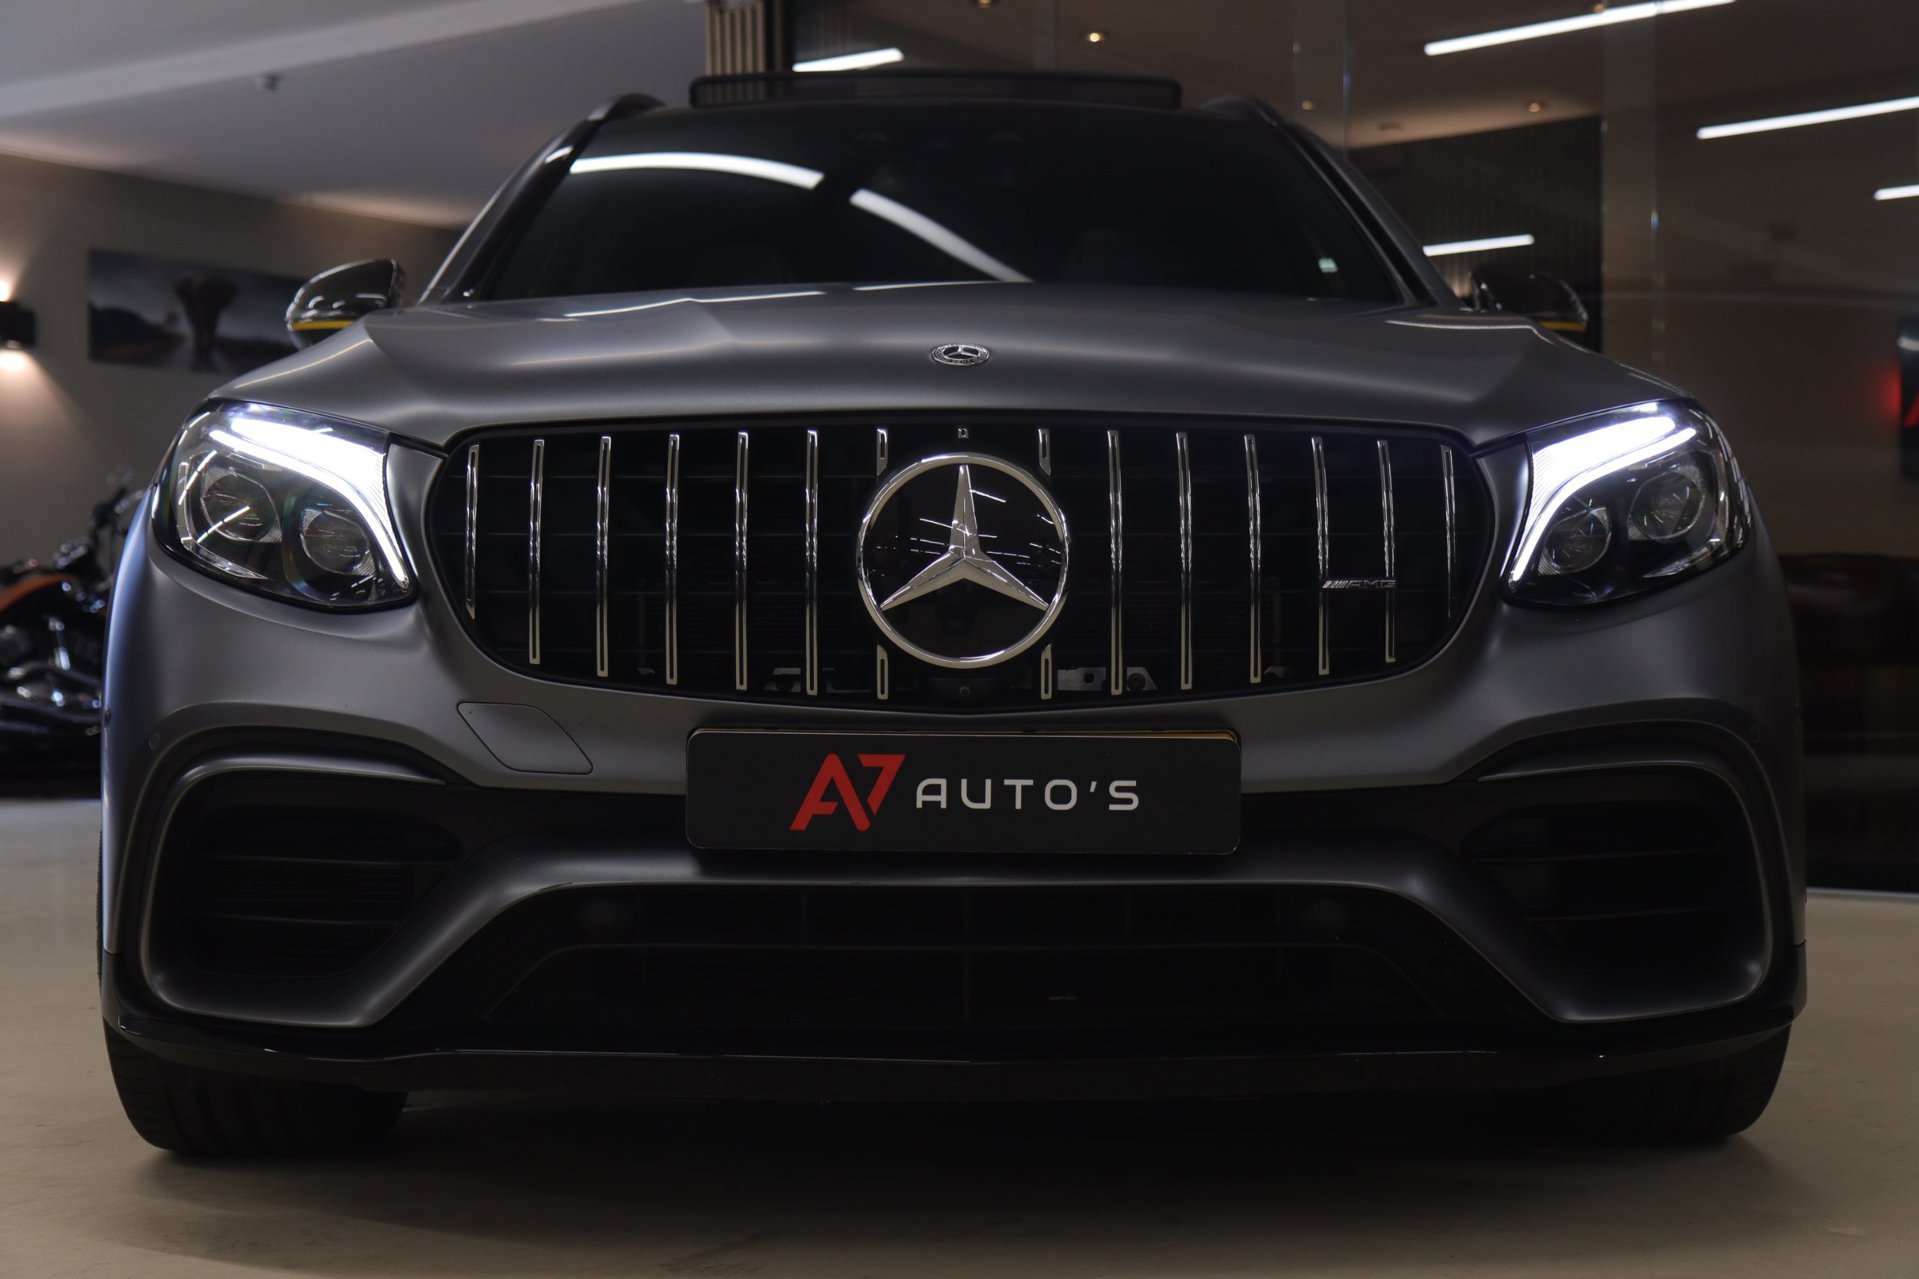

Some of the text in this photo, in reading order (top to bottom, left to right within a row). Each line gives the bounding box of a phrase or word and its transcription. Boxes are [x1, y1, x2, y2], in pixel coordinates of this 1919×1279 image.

[1345, 579, 1397, 589] AMG
[789, 753, 1139, 832] A7 AUTO'S
